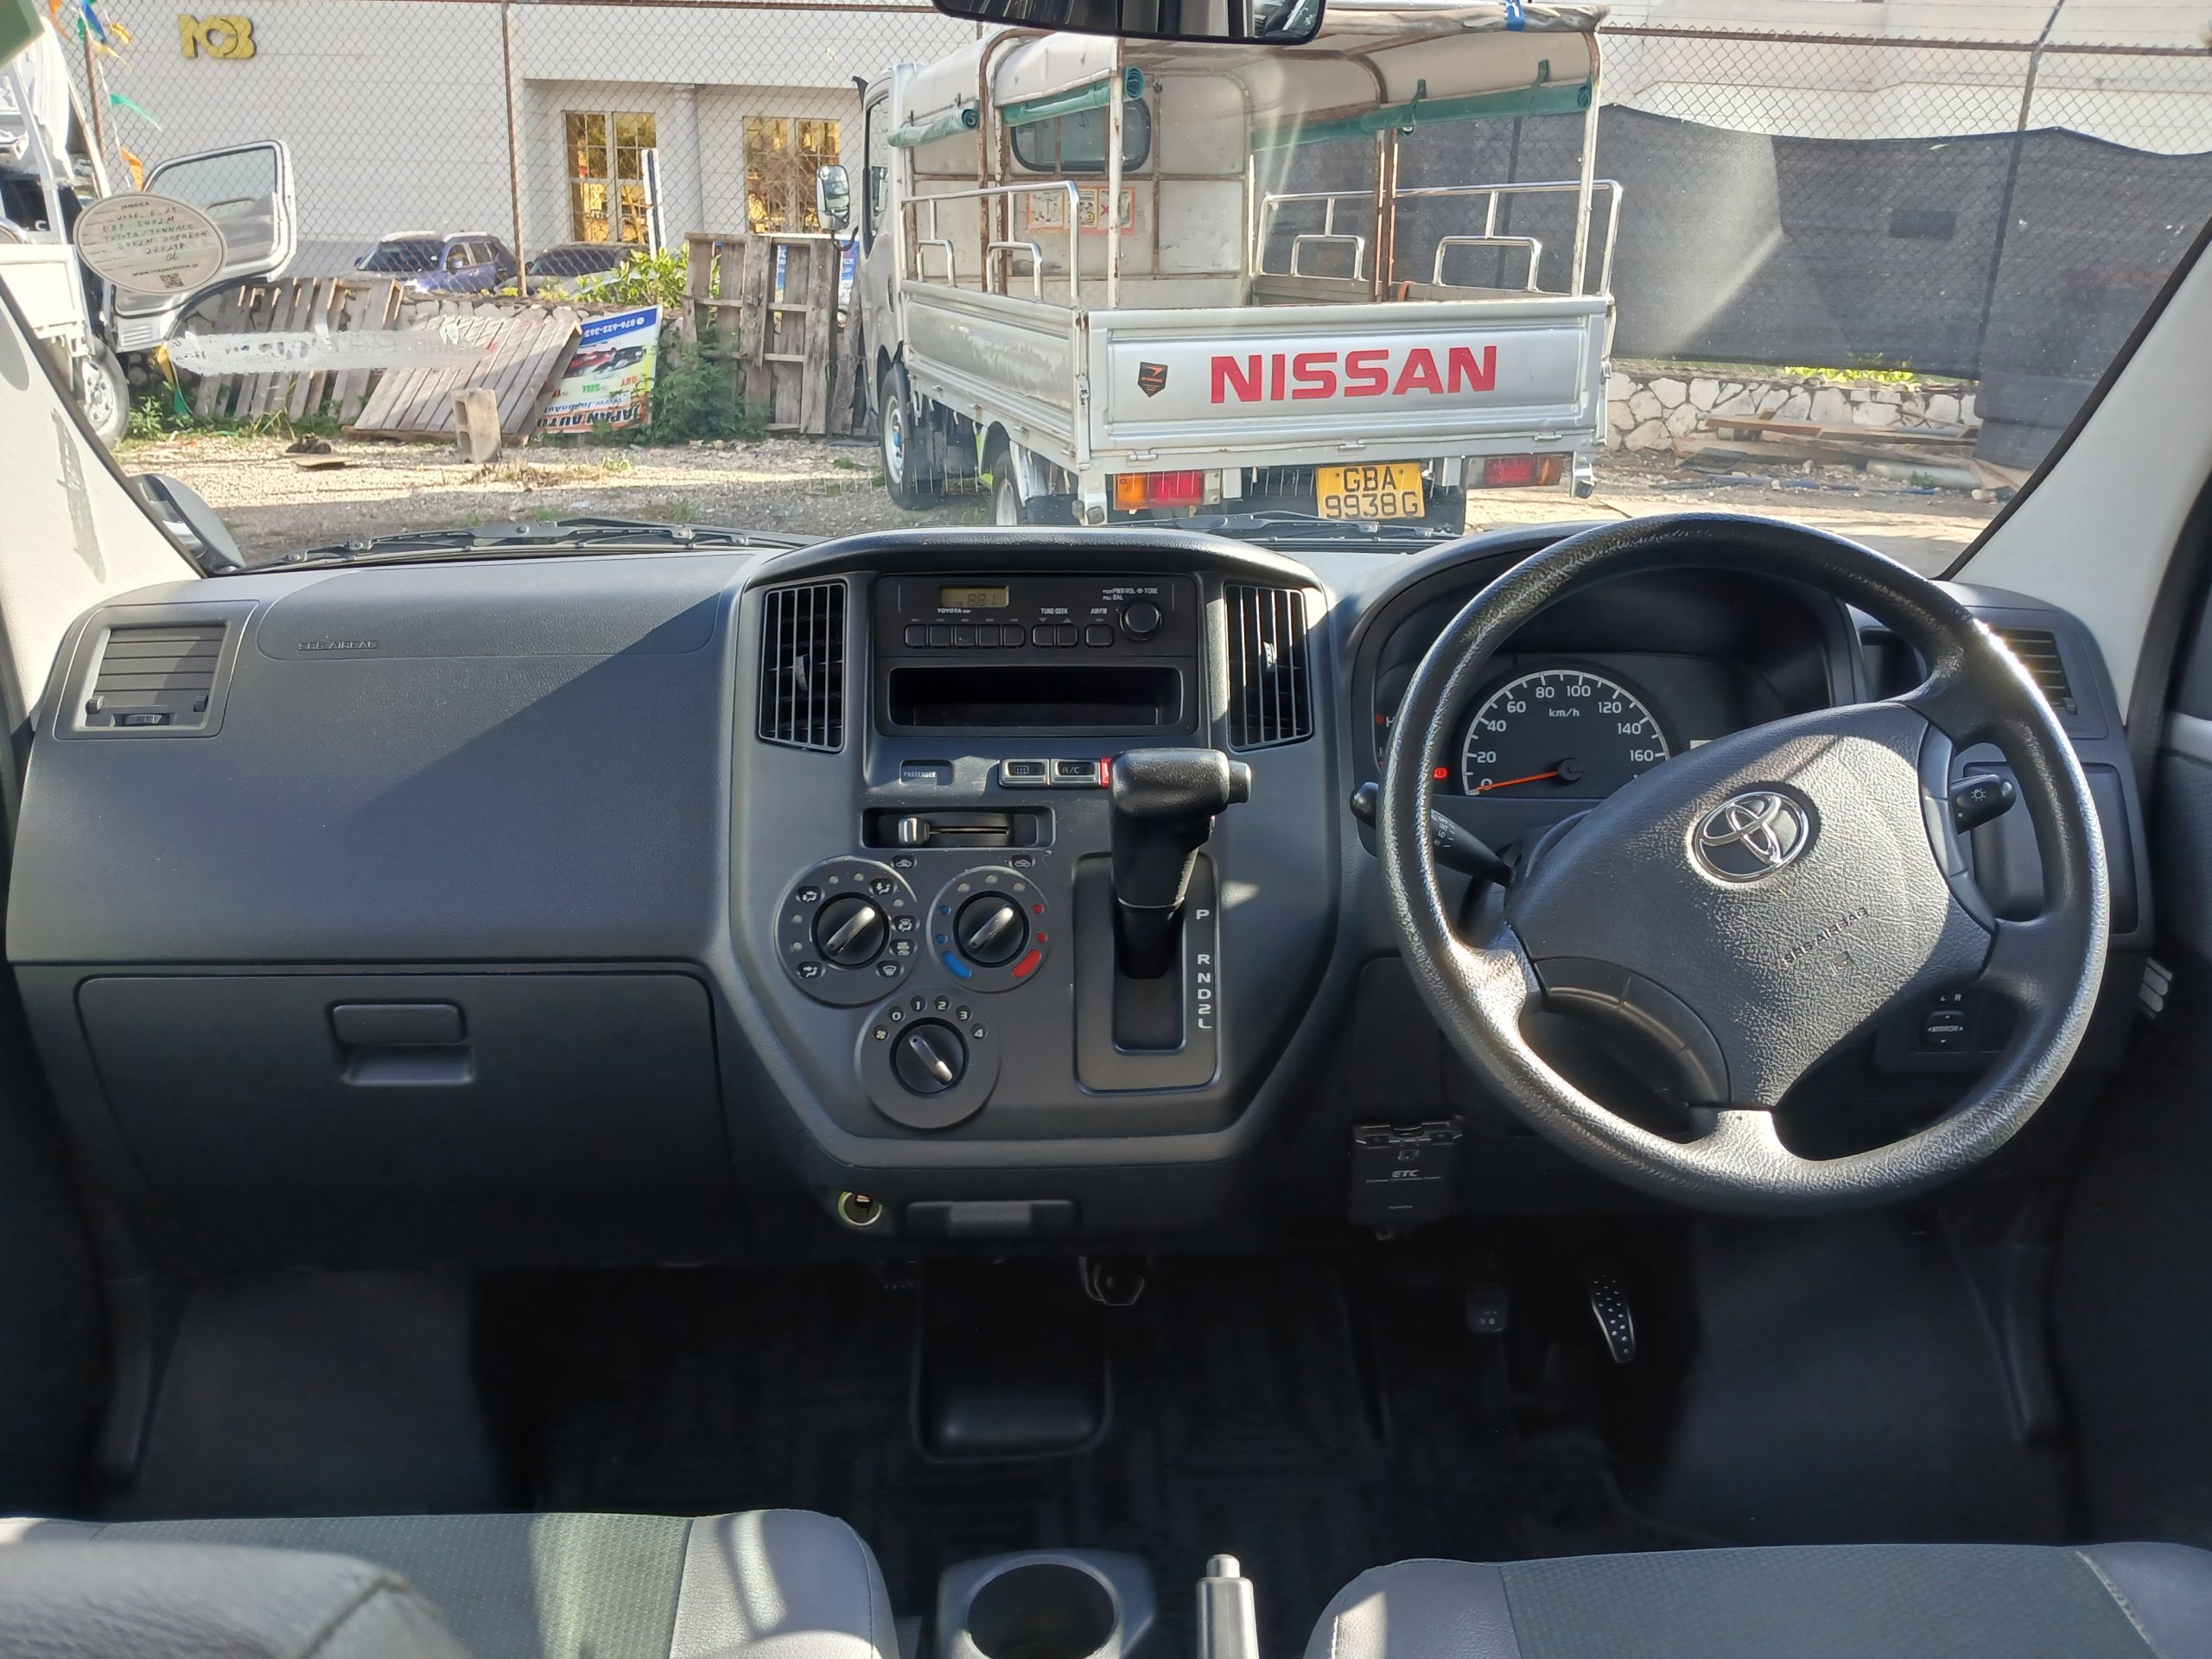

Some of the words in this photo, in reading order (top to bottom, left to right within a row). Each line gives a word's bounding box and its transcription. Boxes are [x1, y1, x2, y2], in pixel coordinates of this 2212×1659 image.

[121, 201, 150, 210] JAMAICA
[584, 318, 635, 338] 876-622-362
[1211, 346, 1497, 404] NISSAN
[582, 384, 601, 393] SELL
[1343, 466, 1396, 492] GBA
[1325, 491, 1418, 518] 9938G
[1535, 686, 1554, 699] 80
[1567, 685, 1592, 697] 100
[1506, 701, 1527, 713] 60
[1599, 702, 1622, 714] 120
[1548, 708, 1580, 717] km/h
[1487, 720, 1507, 732] 40
[1618, 722, 1641, 734] 140
[1477, 751, 1497, 763] 20
[1630, 749, 1654, 761] 160
[1062, 766, 1081, 774] A/C
[1439, 822, 1448, 831] INT
[1437, 830, 1446, 838] LO
[1196, 909, 1210, 919] P
[1197, 954, 1210, 964] R
[1198, 973, 1211, 983] N
[1198, 988, 1211, 1000] D
[916, 1001, 920, 1010] 1
[938, 1001, 946, 1010] 2
[1198, 1004, 1211, 1014] 2
[892, 1012, 901, 1020] 0
[960, 1011, 968, 1020] 3
[1198, 1019, 1211, 1029] L
[975, 1028, 983, 1038] 4
[1392, 1169, 1419, 1178] ETC
